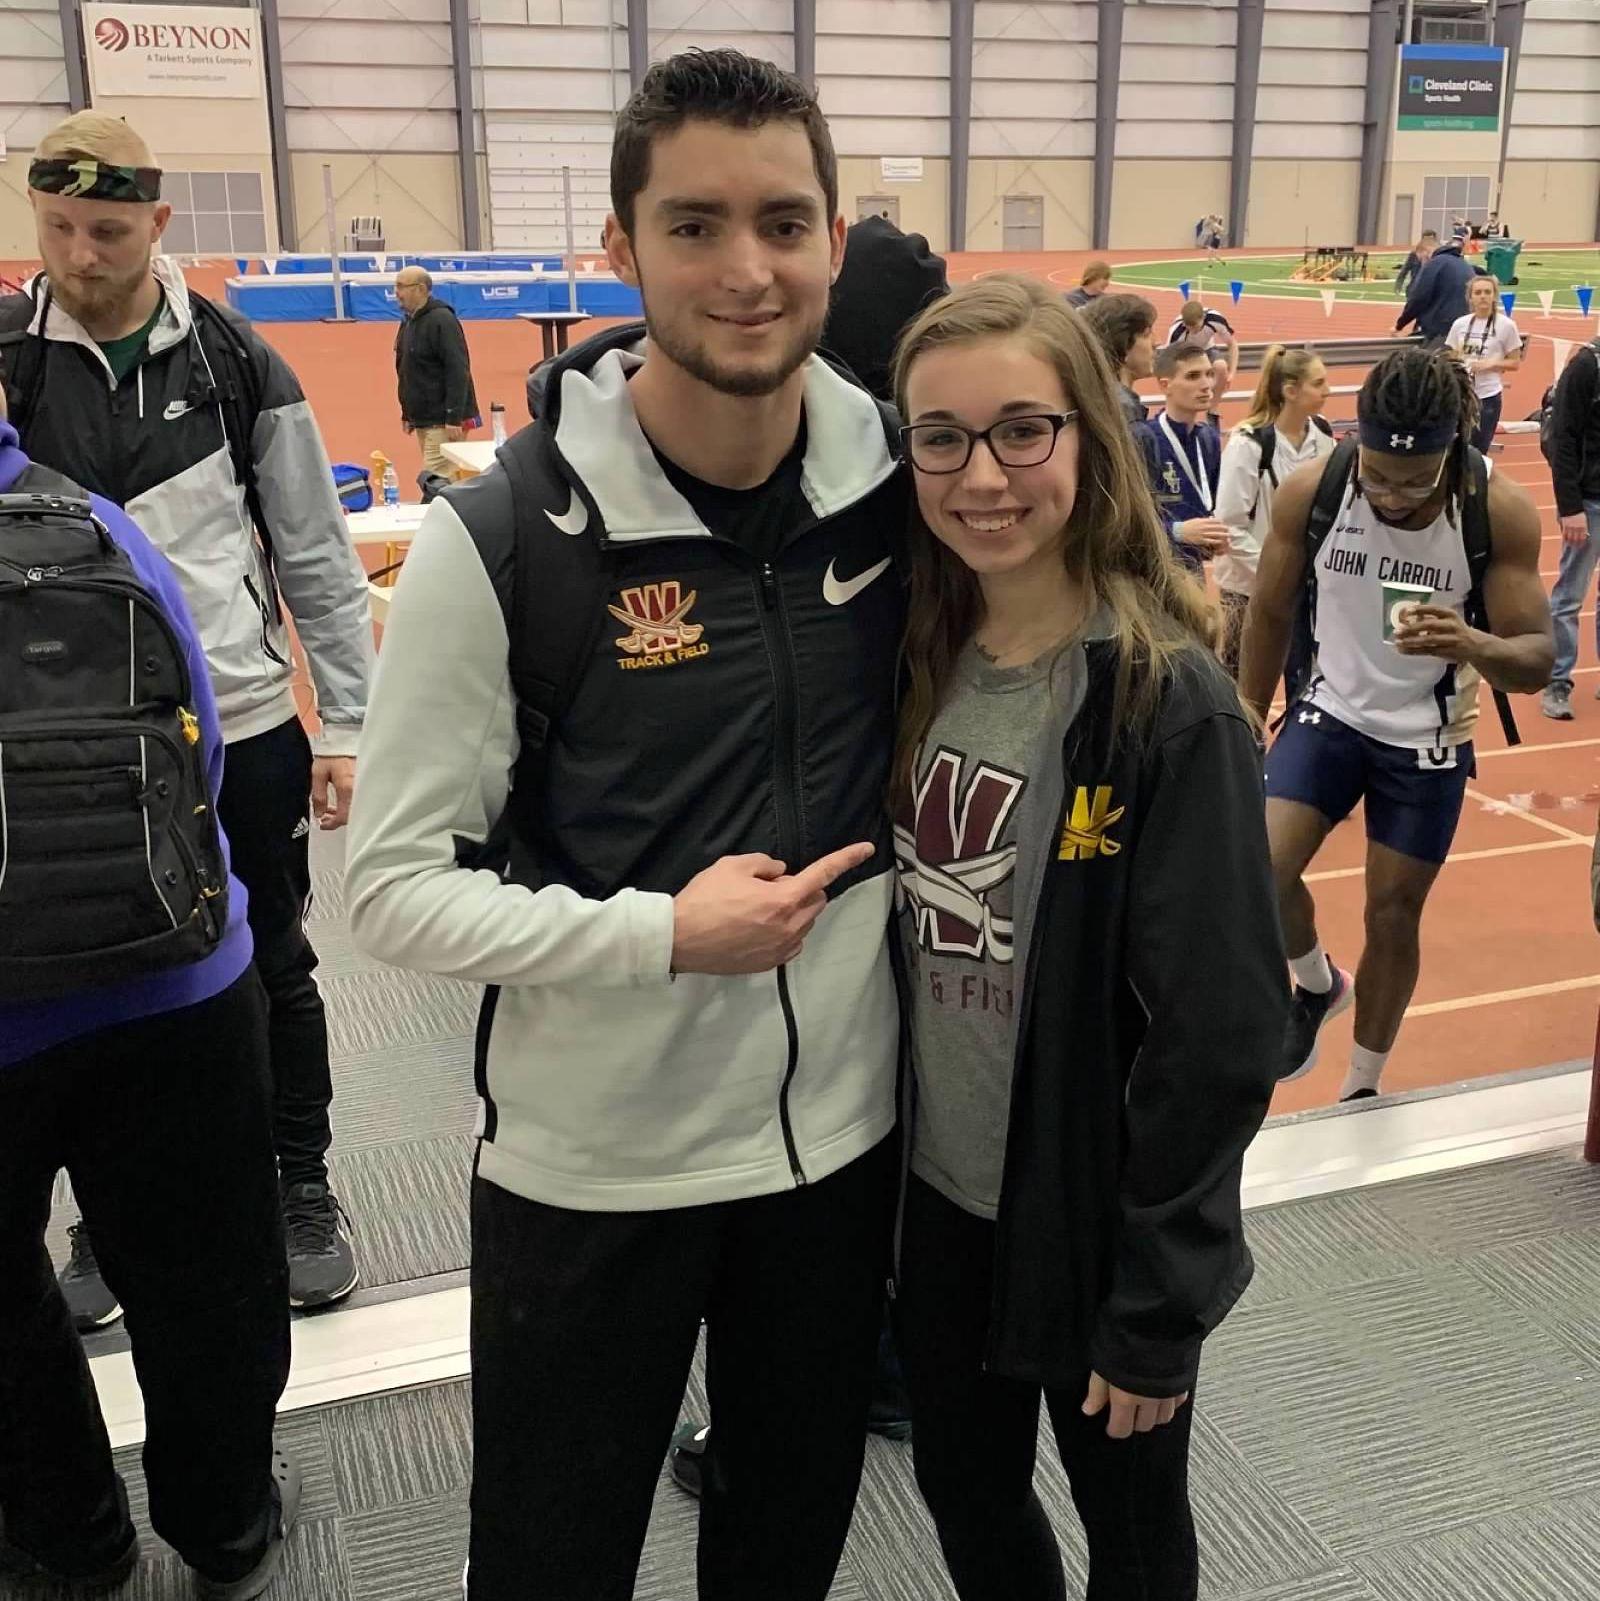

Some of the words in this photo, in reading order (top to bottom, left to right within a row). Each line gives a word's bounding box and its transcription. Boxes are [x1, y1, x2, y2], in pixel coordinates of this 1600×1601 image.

[133, 23, 251, 50] BEYNON
[155, 55, 184, 63] Tarkett
[186, 56, 213, 66] Sports
[215, 57, 252, 66] Company
[1424, 79, 1467, 91] Cleveland
[1468, 80, 1494, 92] Clinic
[482, 286, 520, 297] UCS
[1324, 548, 1368, 577] JOHN
[1378, 556, 1454, 592] CARROLL
[616, 655, 664, 670] TRACK
[664, 651, 676, 663] &
[677, 642, 710, 661] FIELD
